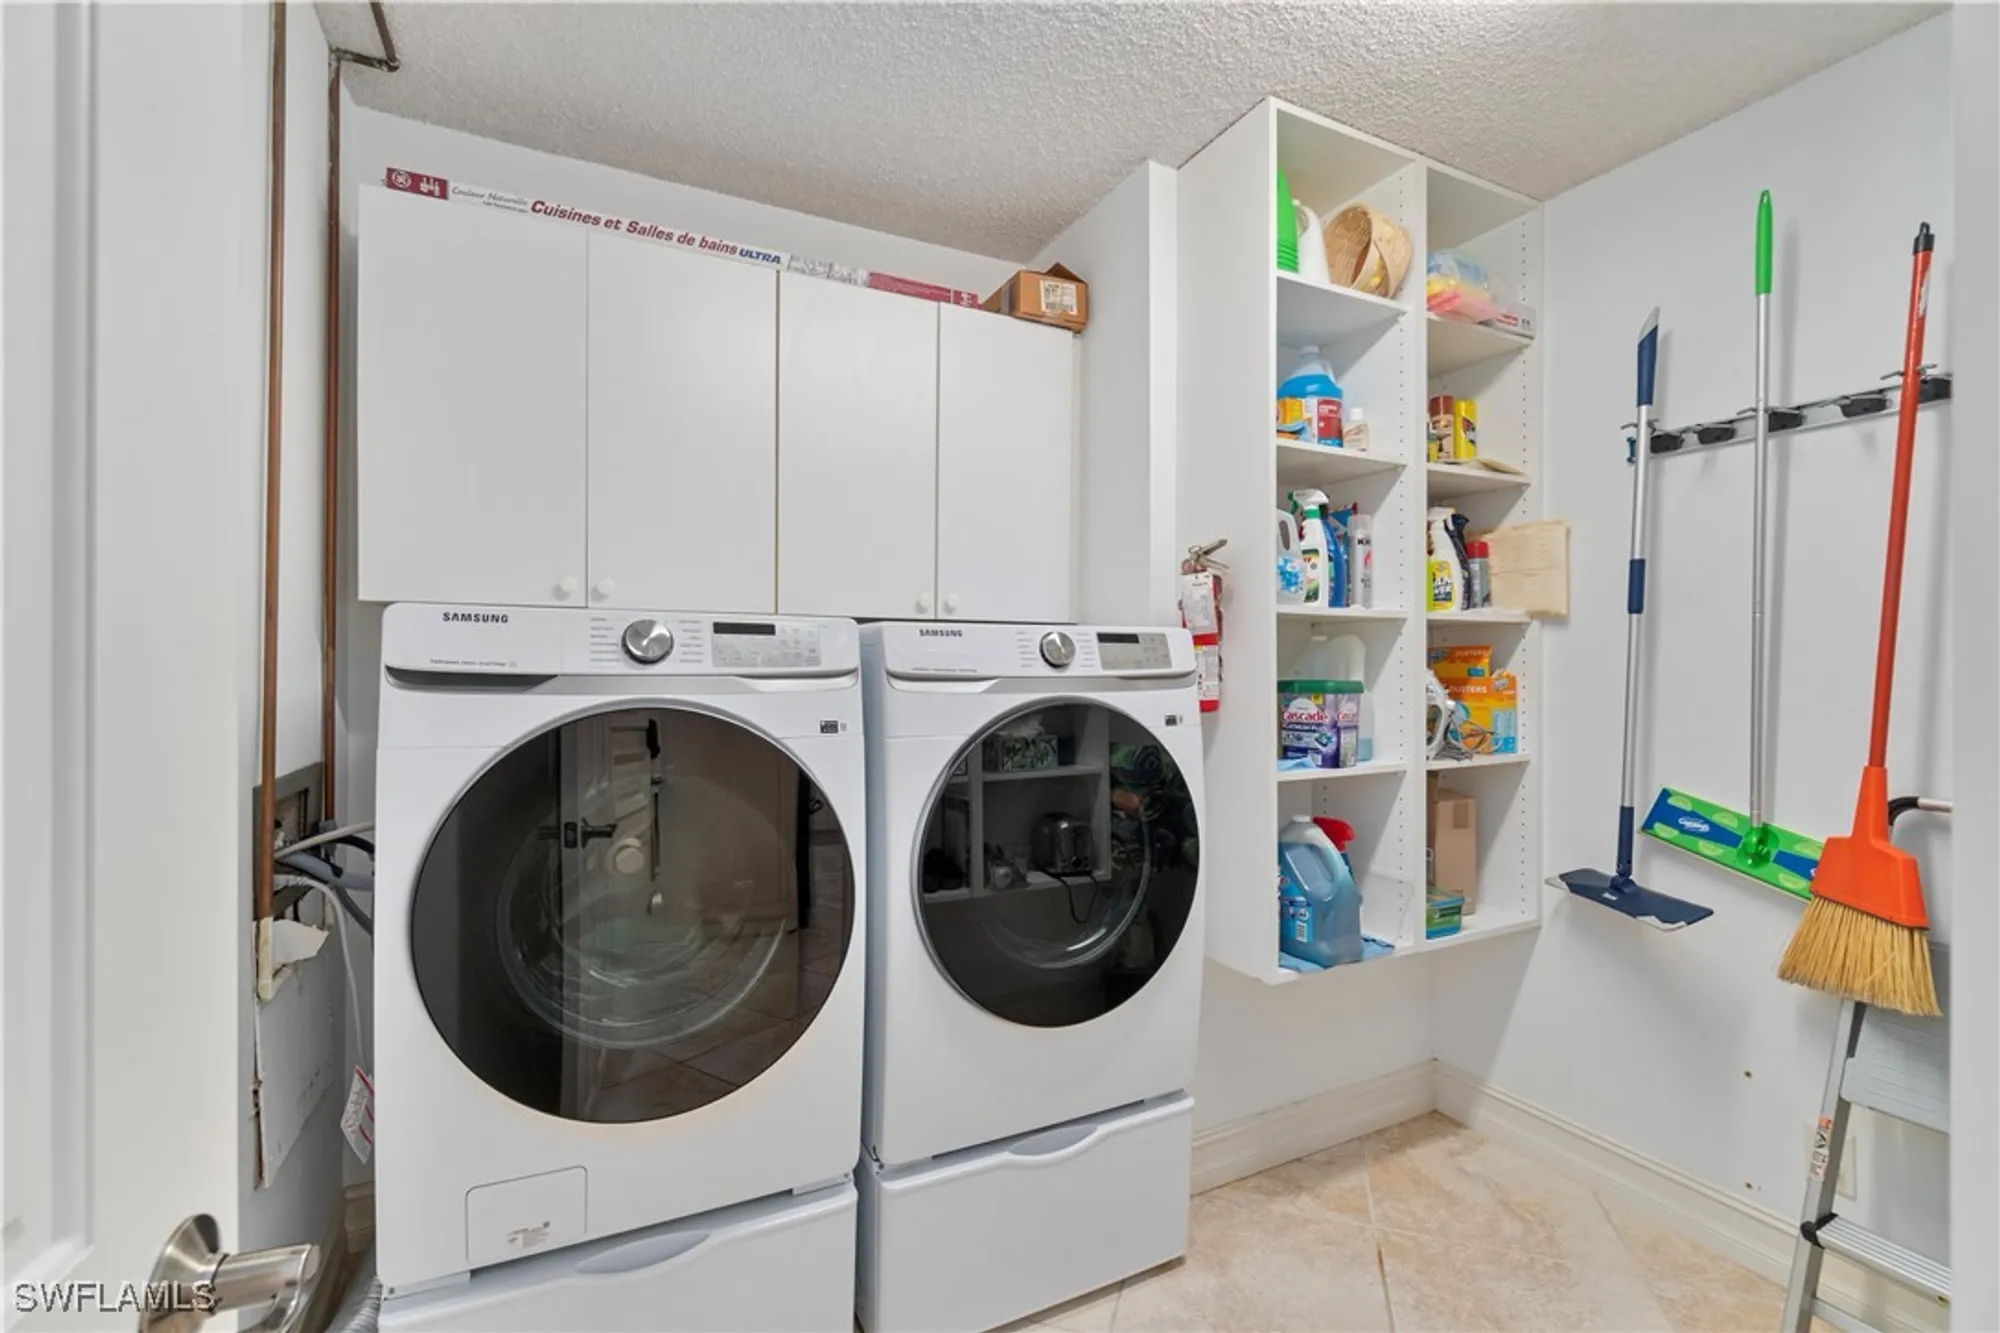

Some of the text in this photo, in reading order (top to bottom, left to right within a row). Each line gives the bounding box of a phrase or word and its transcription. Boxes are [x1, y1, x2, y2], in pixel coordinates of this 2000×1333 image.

[530, 200, 602, 226] Cuisines
[604, 218, 622, 230] et
[626, 220, 674, 242] Salles
[677, 232, 696, 246] de
[698, 236, 738, 256] bains
[739, 247, 781, 264] ULTRA
[442, 612, 509, 624] SAMSUNG
[919, 629, 963, 637] SAMSUNG
